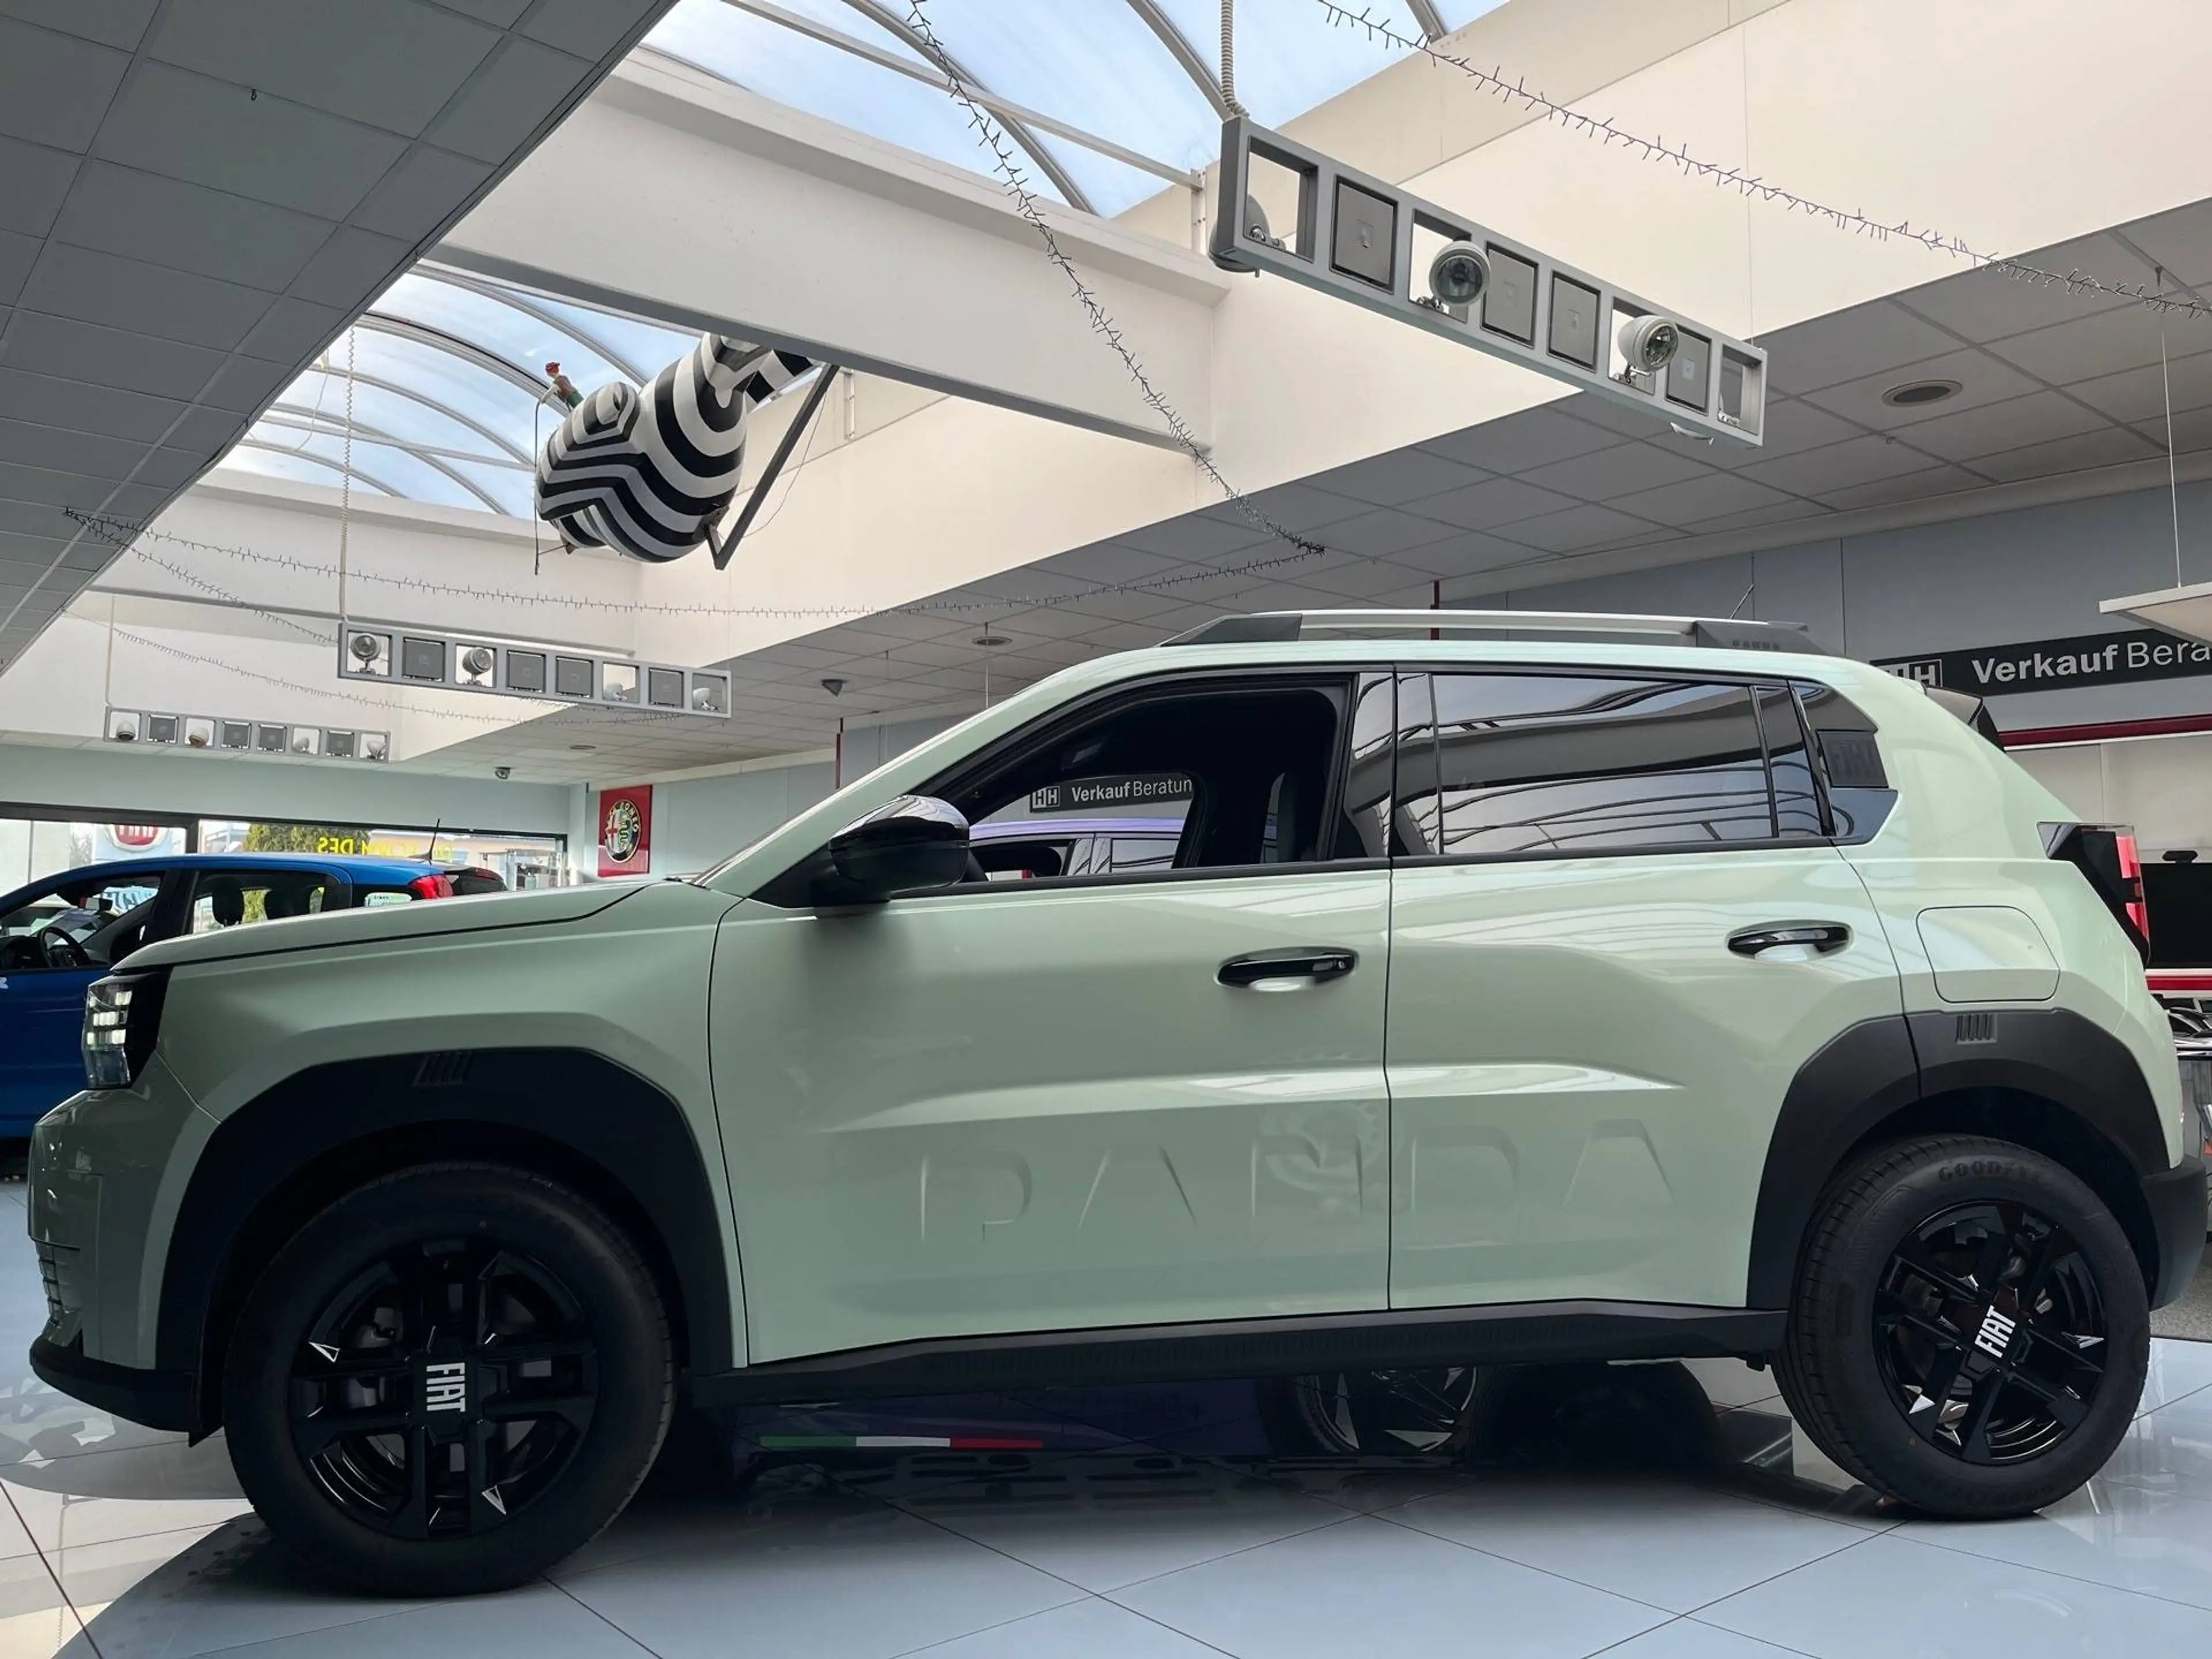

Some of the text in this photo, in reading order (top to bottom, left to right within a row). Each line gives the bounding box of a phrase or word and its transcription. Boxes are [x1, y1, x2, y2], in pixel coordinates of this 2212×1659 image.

[1971, 645, 2119, 684] Verkauf
[1071, 782, 1130, 802] Verkauf
[919, 1116, 1676, 1244] PANDA
[1975, 1305, 2016, 1358] FIAT
[426, 1363, 465, 1412] FIAT
